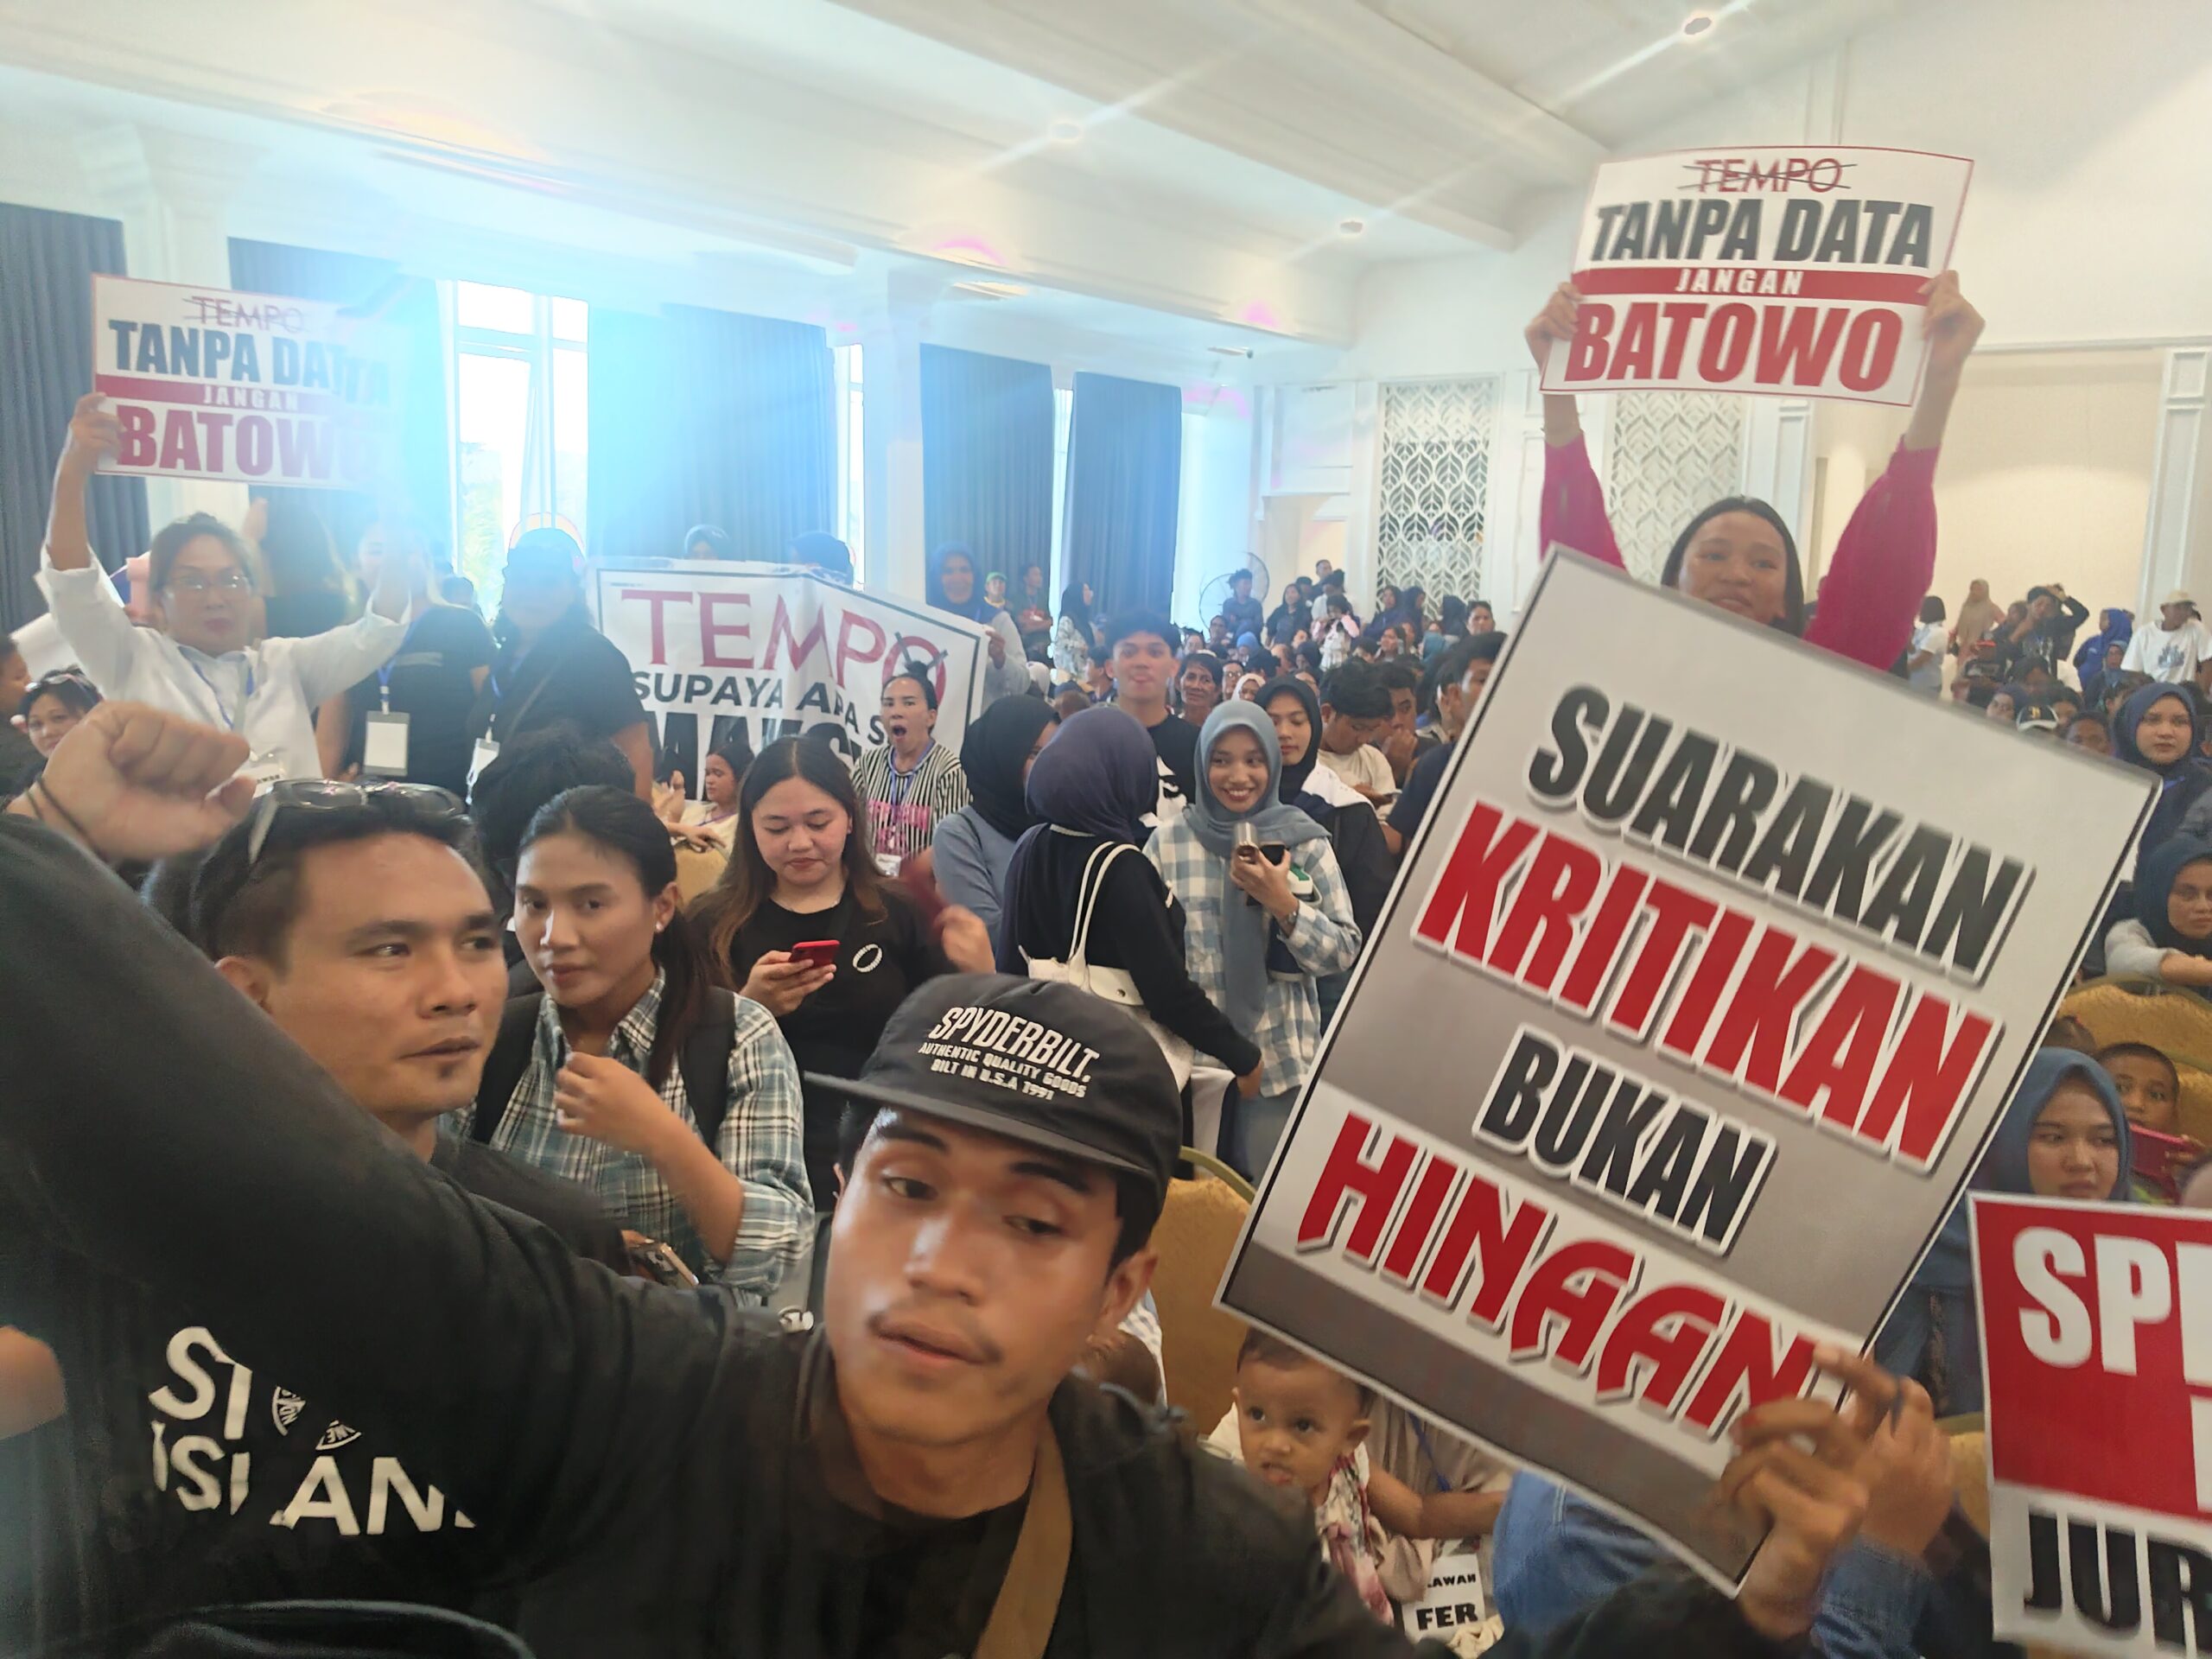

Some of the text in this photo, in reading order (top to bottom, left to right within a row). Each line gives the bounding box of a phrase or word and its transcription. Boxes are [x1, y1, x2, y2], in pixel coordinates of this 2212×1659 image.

[1695, 157, 1843, 193] TEMPO
[1590, 199, 1935, 268] TANPA DATA
[1675, 268, 1804, 296] JANGAN
[191, 295, 305, 334] TEMPO
[109, 319, 262, 383] TANPA
[1564, 302, 1904, 392] BATOWO
[203, 383, 299, 411] JANGAN
[620, 588, 947, 710] TEMPO
[633, 671, 783, 709] SUPAYA
[1528, 685, 2025, 976] SUARAKAN
[1417, 800, 1997, 1166] KRITIKAN
[918, 1042, 1086, 1097] AUTHENTIC QUALITY GOODS
[961, 1065, 977, 1079] IN
[1478, 1031, 1772, 1246] BUKAN
[1427, 1573, 1476, 1588] AWAN
[1416, 1603, 1478, 1631] FER
